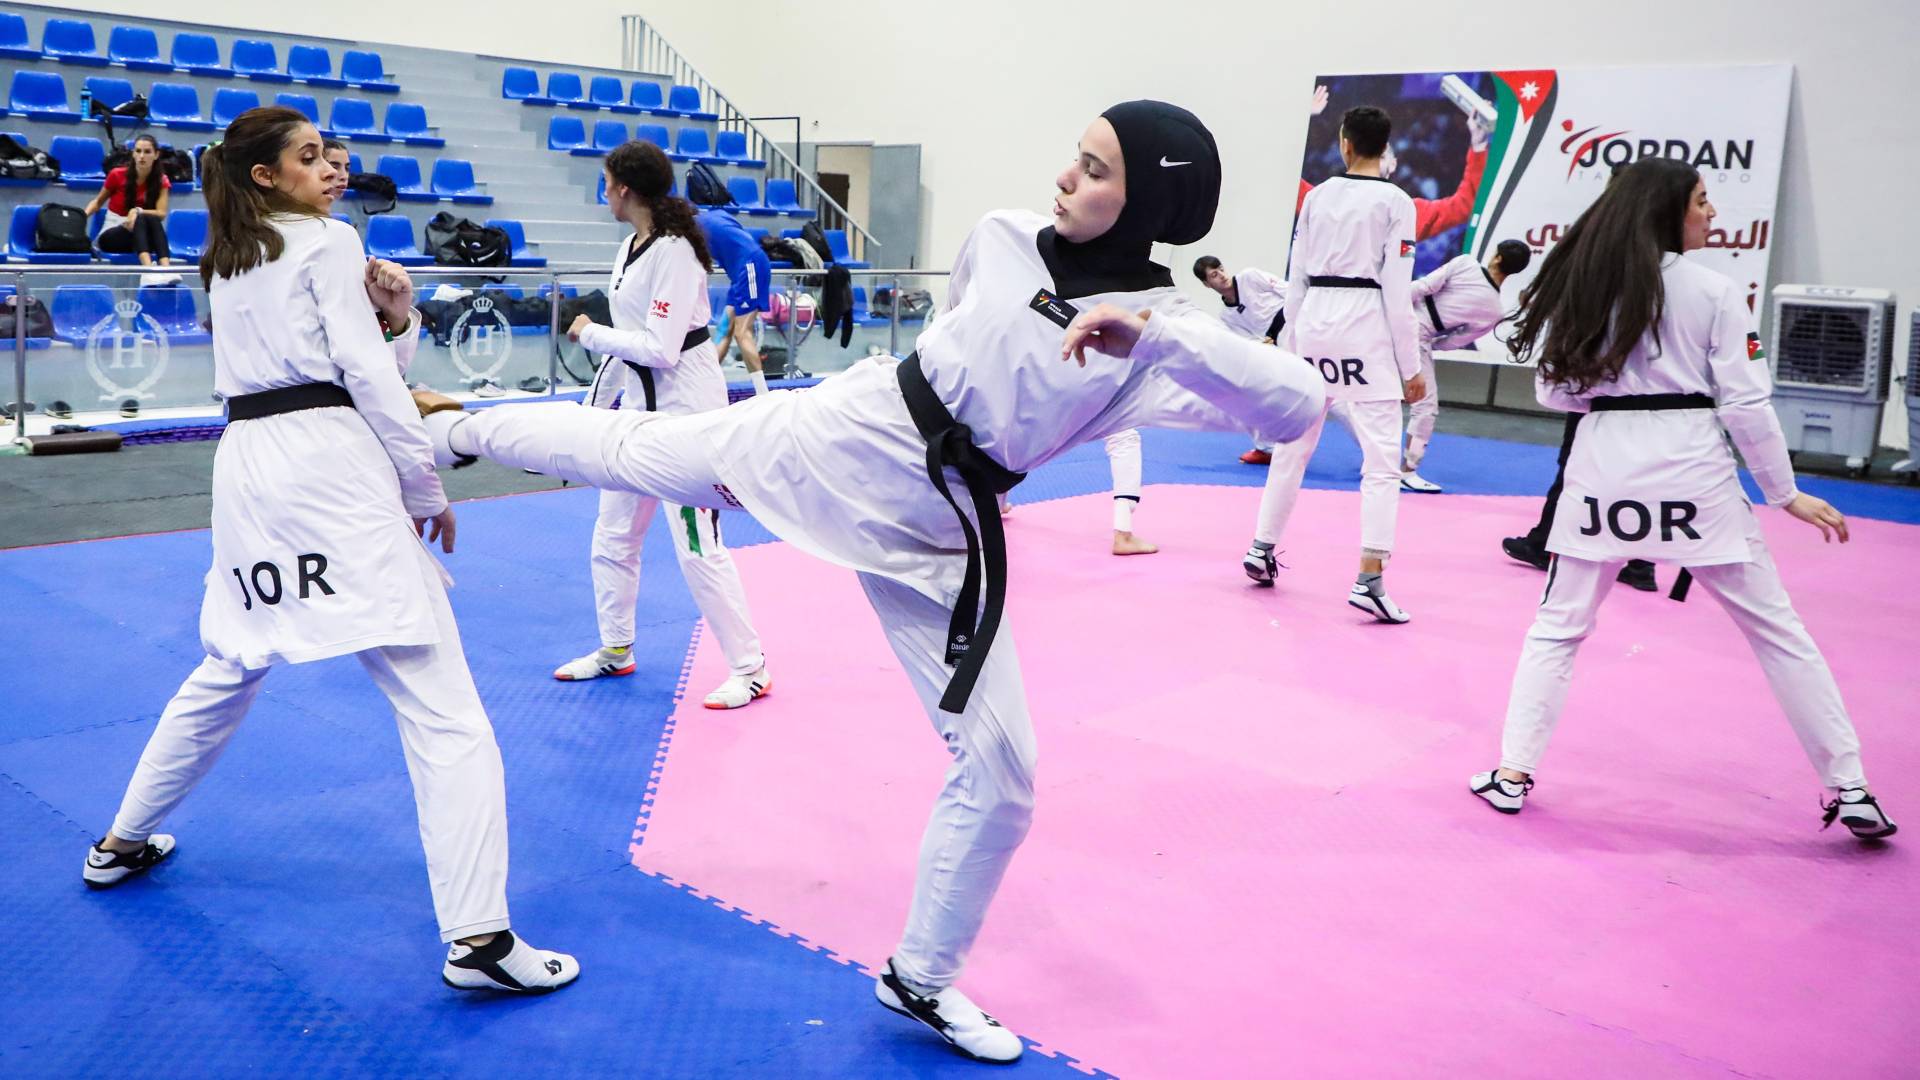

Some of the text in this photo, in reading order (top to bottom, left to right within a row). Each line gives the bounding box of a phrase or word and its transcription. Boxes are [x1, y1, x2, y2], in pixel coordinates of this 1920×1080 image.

[1579, 139, 1754, 169] JORDAN
[1303, 356, 1369, 386] OR
[1580, 495, 1703, 542] JOR
[232, 553, 337, 611] JOR
